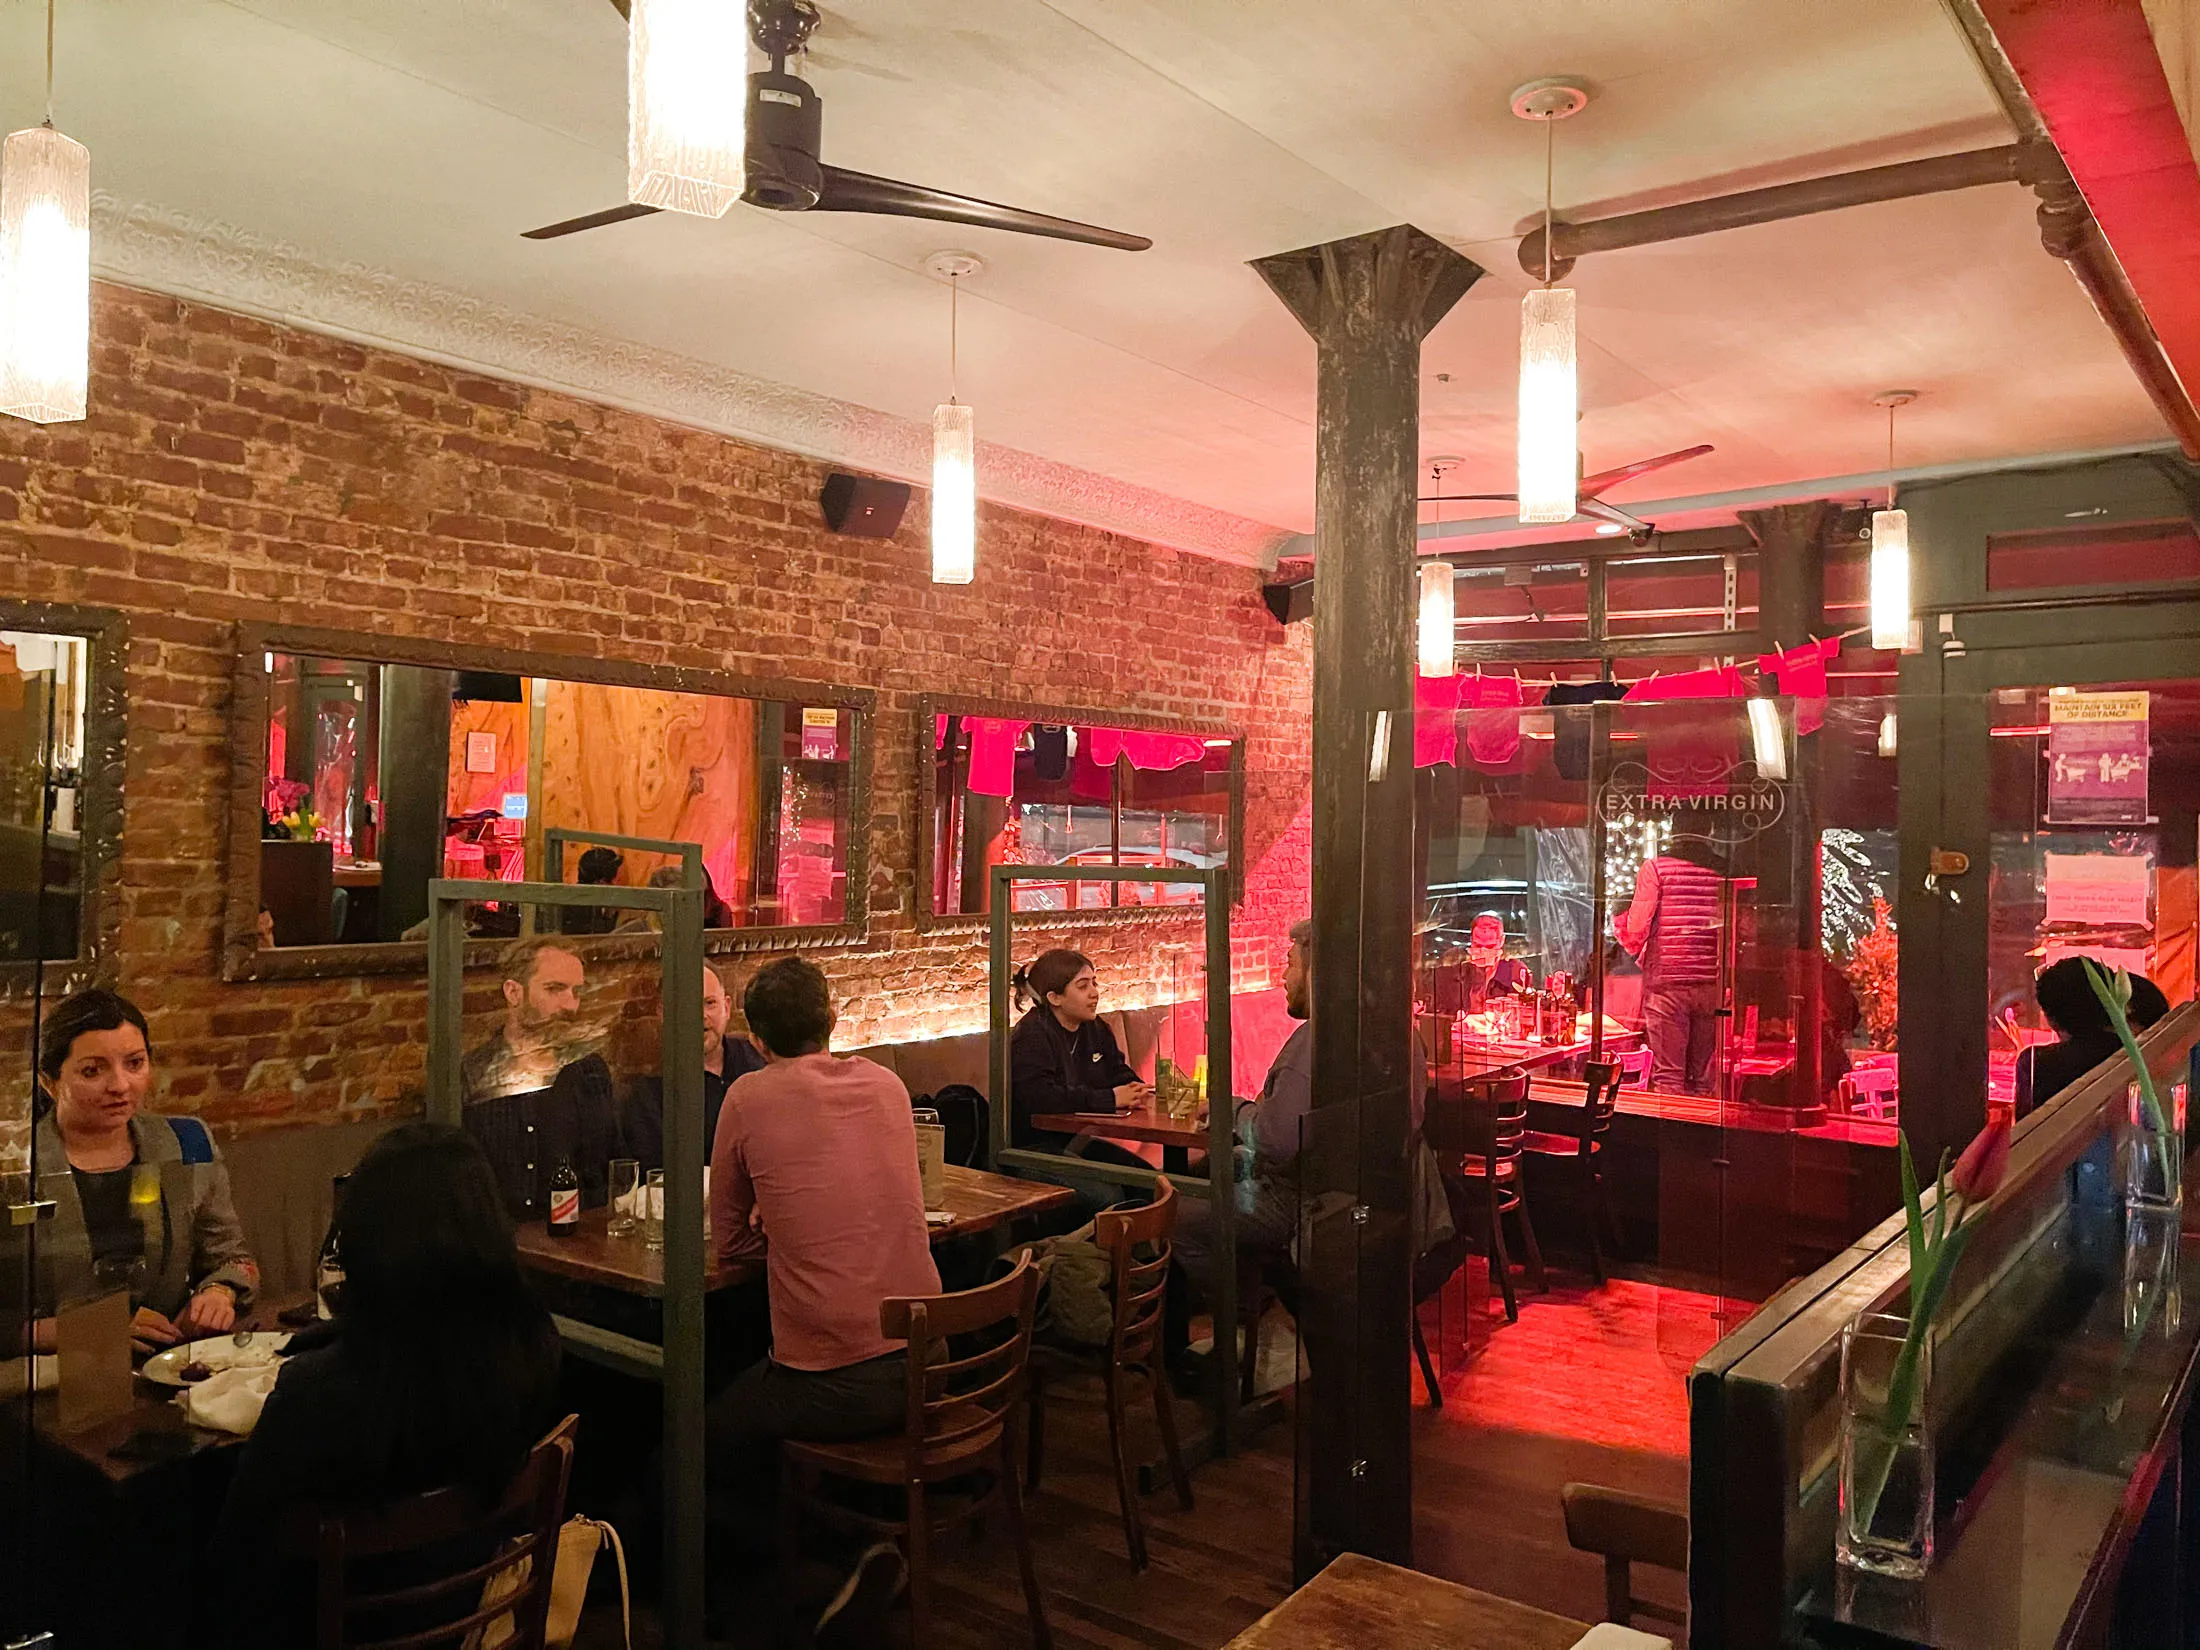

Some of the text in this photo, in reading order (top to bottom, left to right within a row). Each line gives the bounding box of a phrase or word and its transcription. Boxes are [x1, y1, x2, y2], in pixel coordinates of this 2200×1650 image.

[2119, 702, 2142, 710] FEET
[2081, 710, 2127, 718] DISTANCE
[1606, 794, 1774, 810] EXTRA VIRGIN
